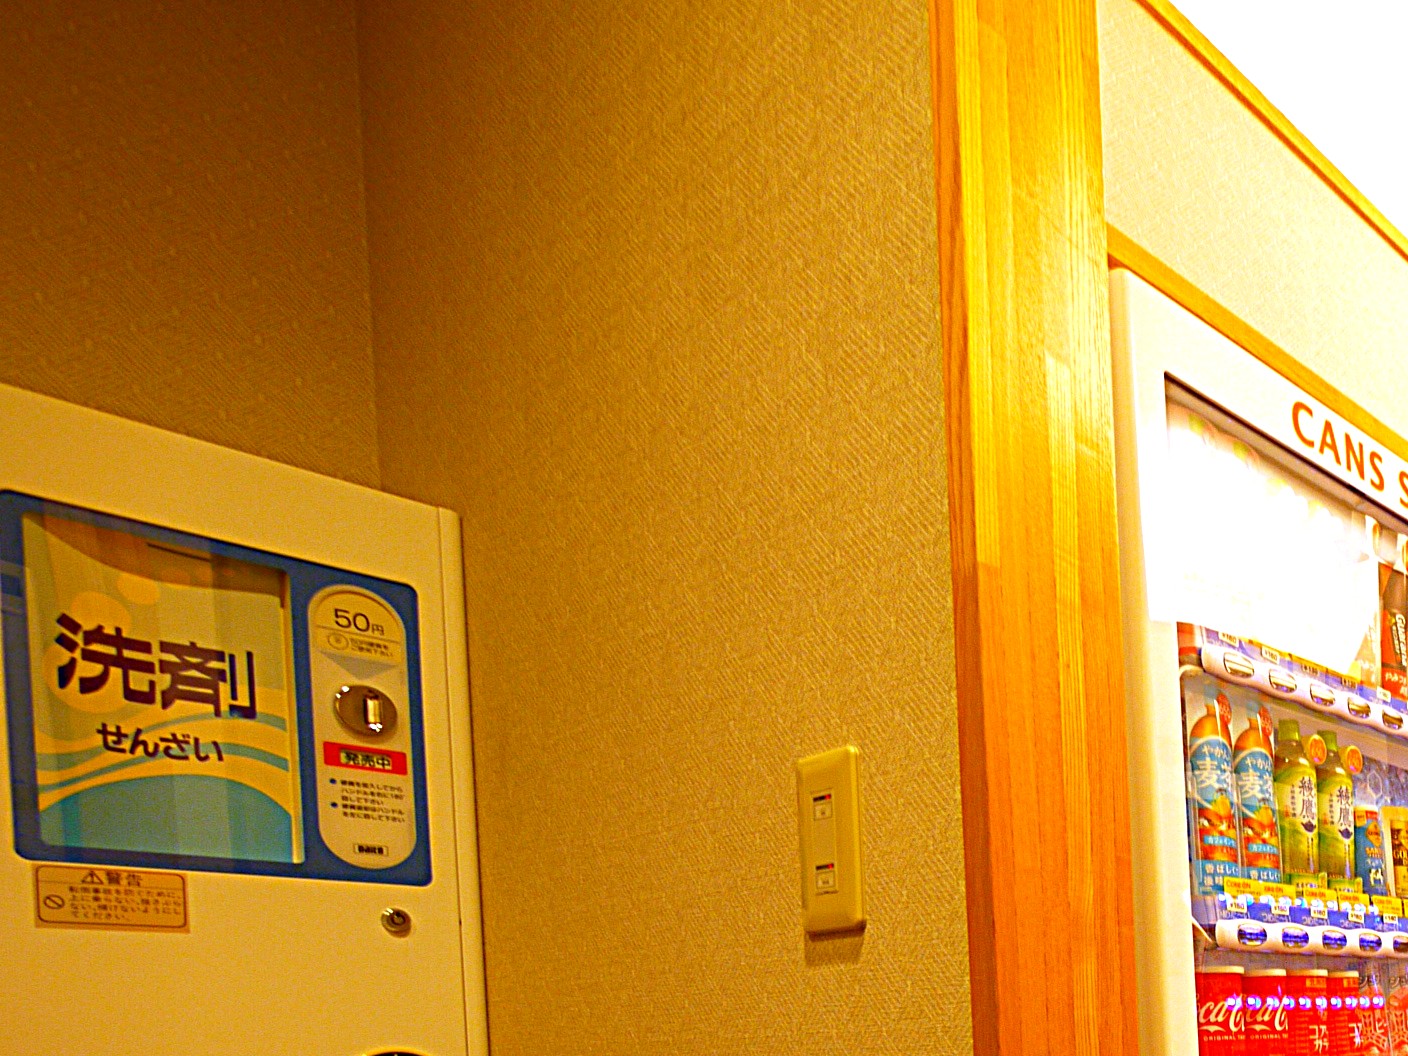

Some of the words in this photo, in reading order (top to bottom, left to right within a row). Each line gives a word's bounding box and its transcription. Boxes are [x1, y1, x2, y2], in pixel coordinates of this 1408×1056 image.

[1292, 401, 1385, 492] CANS
[334, 607, 385, 636] 50円
[55, 612, 257, 720] 洗剤
[97, 722, 224, 762] せんざい
[344, 750, 391, 769] 発売中
